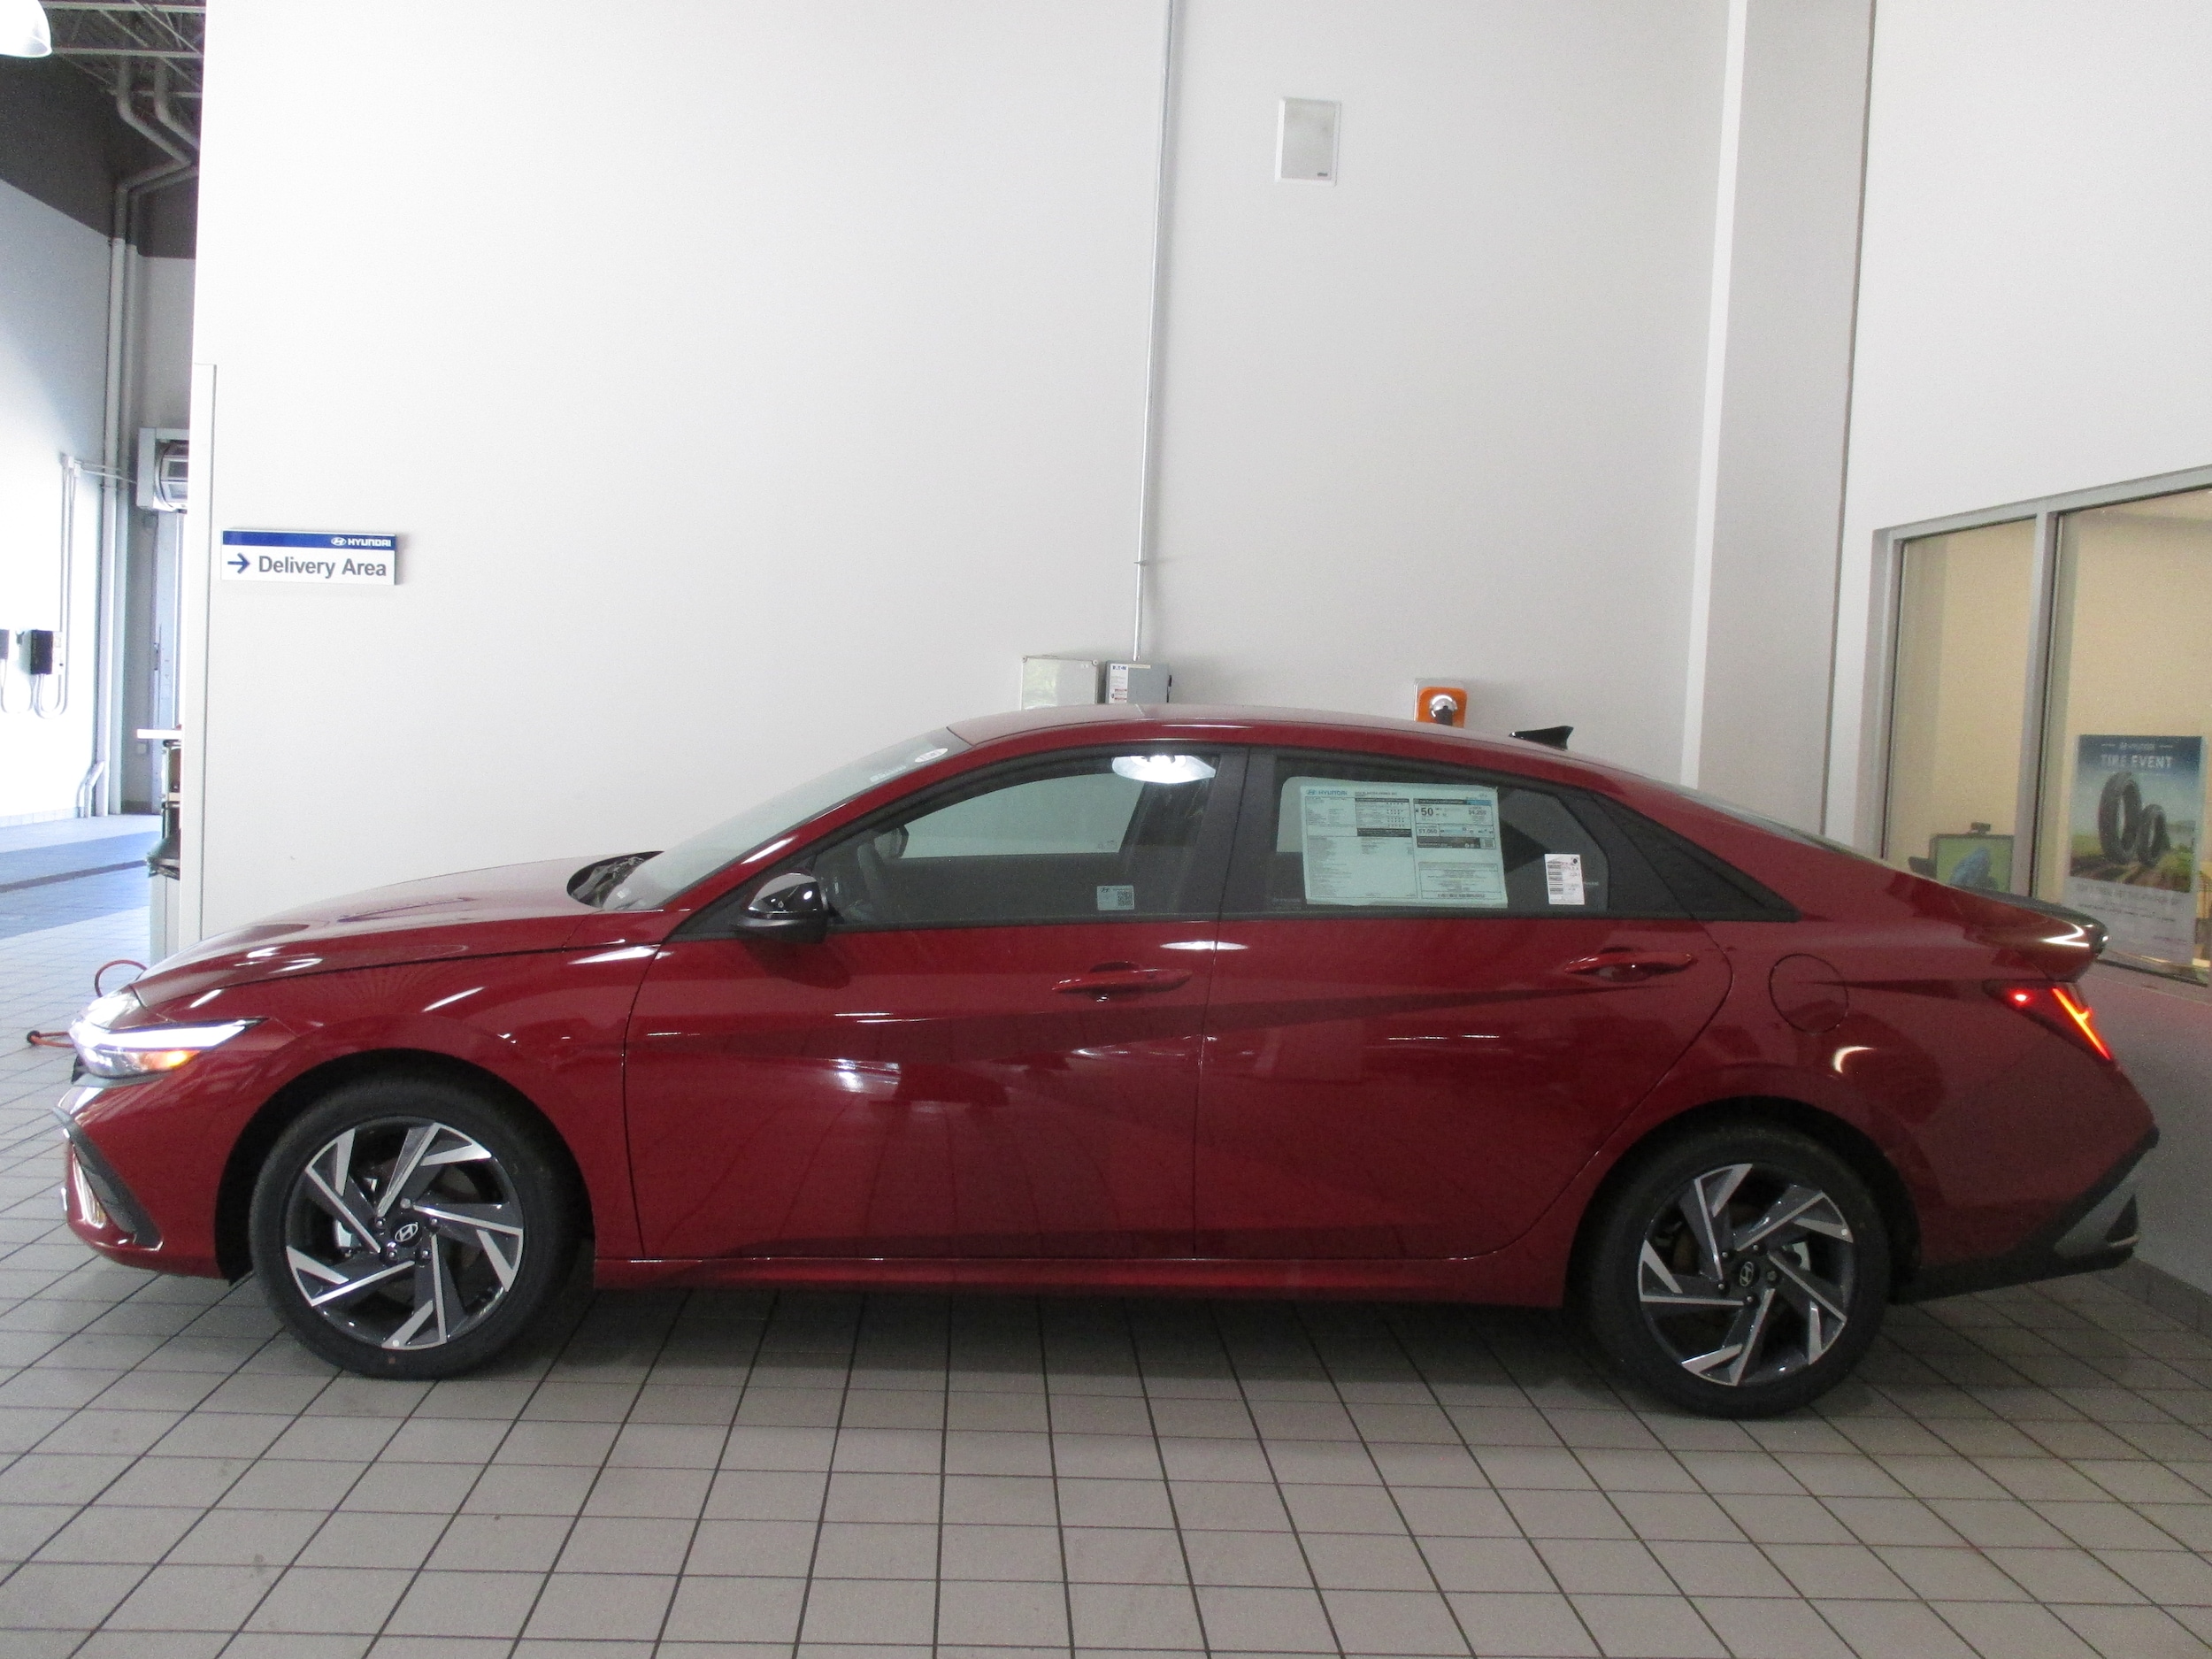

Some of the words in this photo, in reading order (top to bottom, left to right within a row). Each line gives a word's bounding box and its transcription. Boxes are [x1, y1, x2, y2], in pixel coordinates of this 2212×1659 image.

[347, 539, 391, 548] HYUNDAI
[258, 556, 335, 578] Delivery
[342, 557, 388, 576] Area
[2131, 754, 2174, 769] EVENT
[1420, 807, 1434, 817] 50
